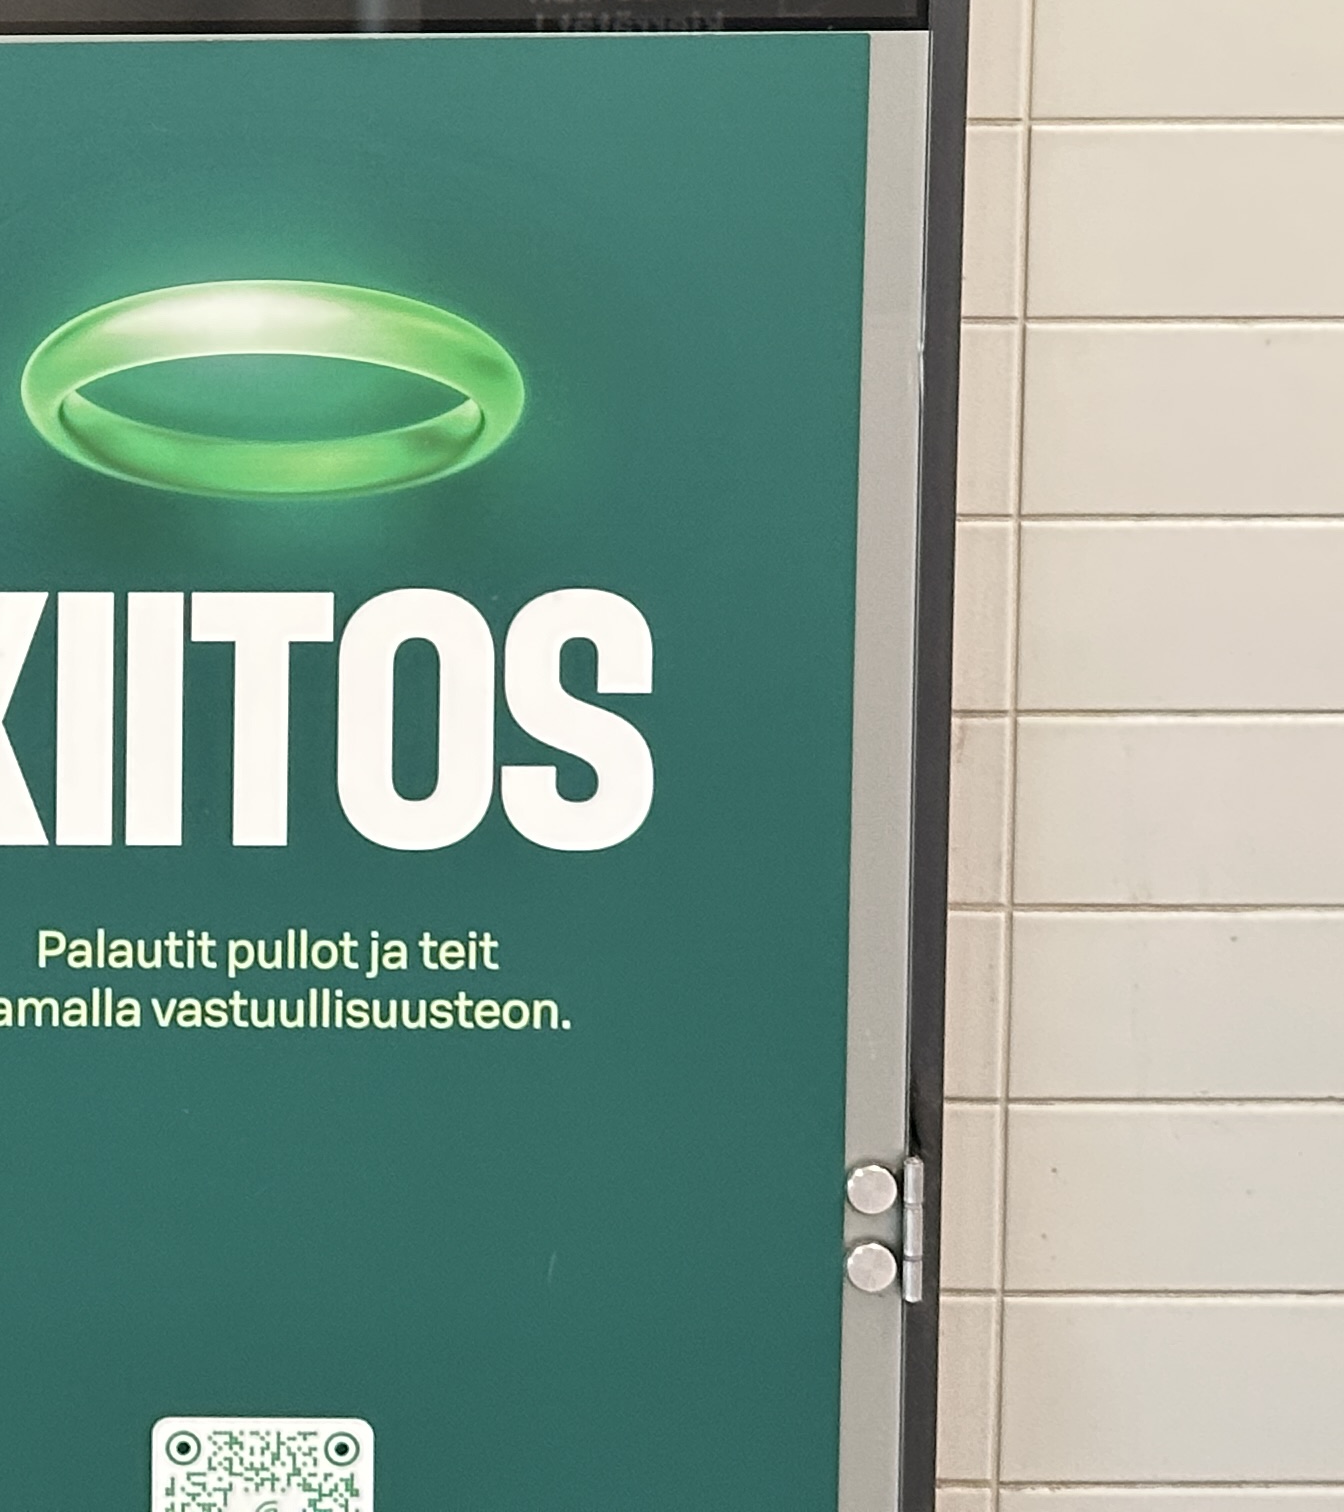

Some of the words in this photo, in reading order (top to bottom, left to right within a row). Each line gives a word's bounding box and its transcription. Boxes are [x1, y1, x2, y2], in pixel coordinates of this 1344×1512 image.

[38, 930, 218, 969] Palautit
[228, 929, 359, 979] pullot
[366, 932, 408, 978] ja
[419, 930, 500, 969] teit
[151, 987, 572, 1030] vastuullisuusteon.
